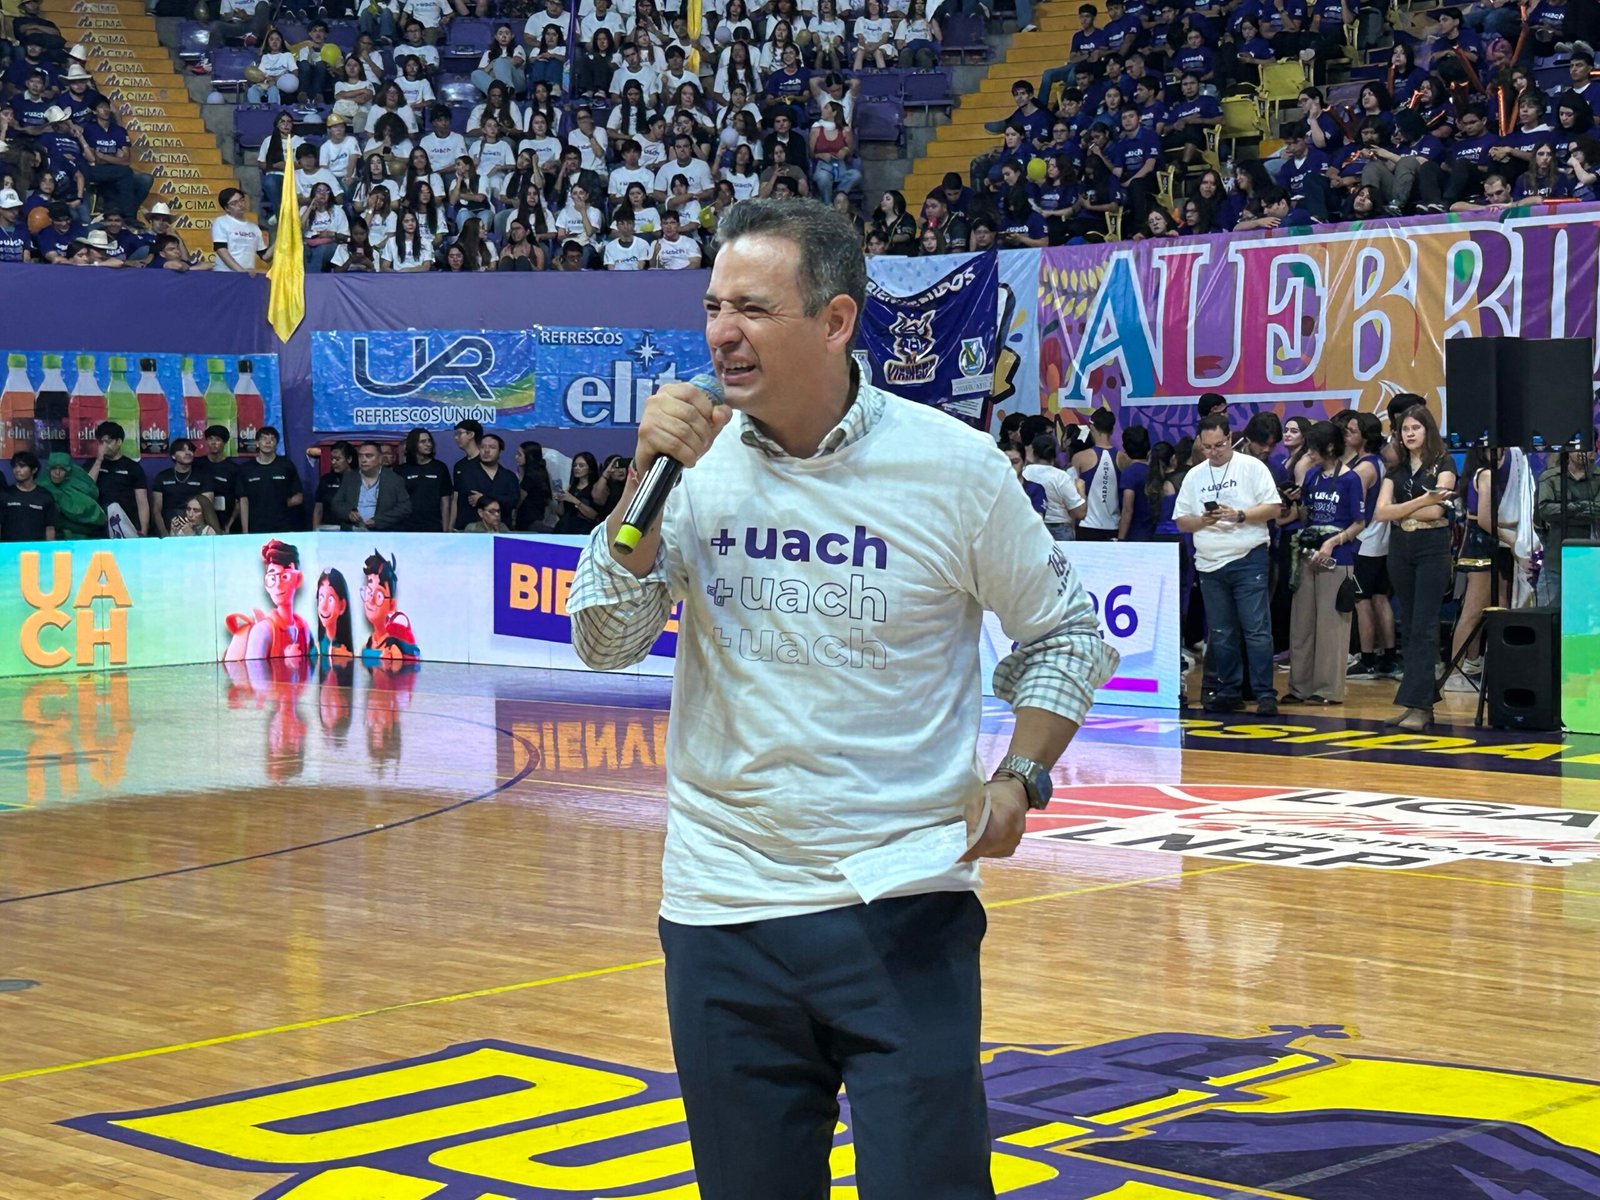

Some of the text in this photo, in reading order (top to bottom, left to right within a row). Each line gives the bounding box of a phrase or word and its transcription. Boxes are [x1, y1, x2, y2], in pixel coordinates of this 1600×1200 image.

[114, 63, 144, 72] CIMA
[122, 78, 151, 86] CIMA
[152, 138, 182, 147] CIMA
[159, 154, 190, 163] CIMA
[170, 169, 200, 178] CIMA
[179, 185, 209, 194] CIMA
[185, 200, 216, 209] CIMA
[540, 331, 624, 345] REFRESCOS
[354, 404, 496, 423] REFRESCOS UNIÓN
[78, 425, 97, 440] elit
[142, 426, 167, 440] elite
[186, 427, 204, 439] lite
[240, 427, 257, 440] elit
[1276, 790, 1599, 828] LIGA
[1042, 826, 1431, 867] LNBP
[1240, 827, 1568, 864] caliente.mx
